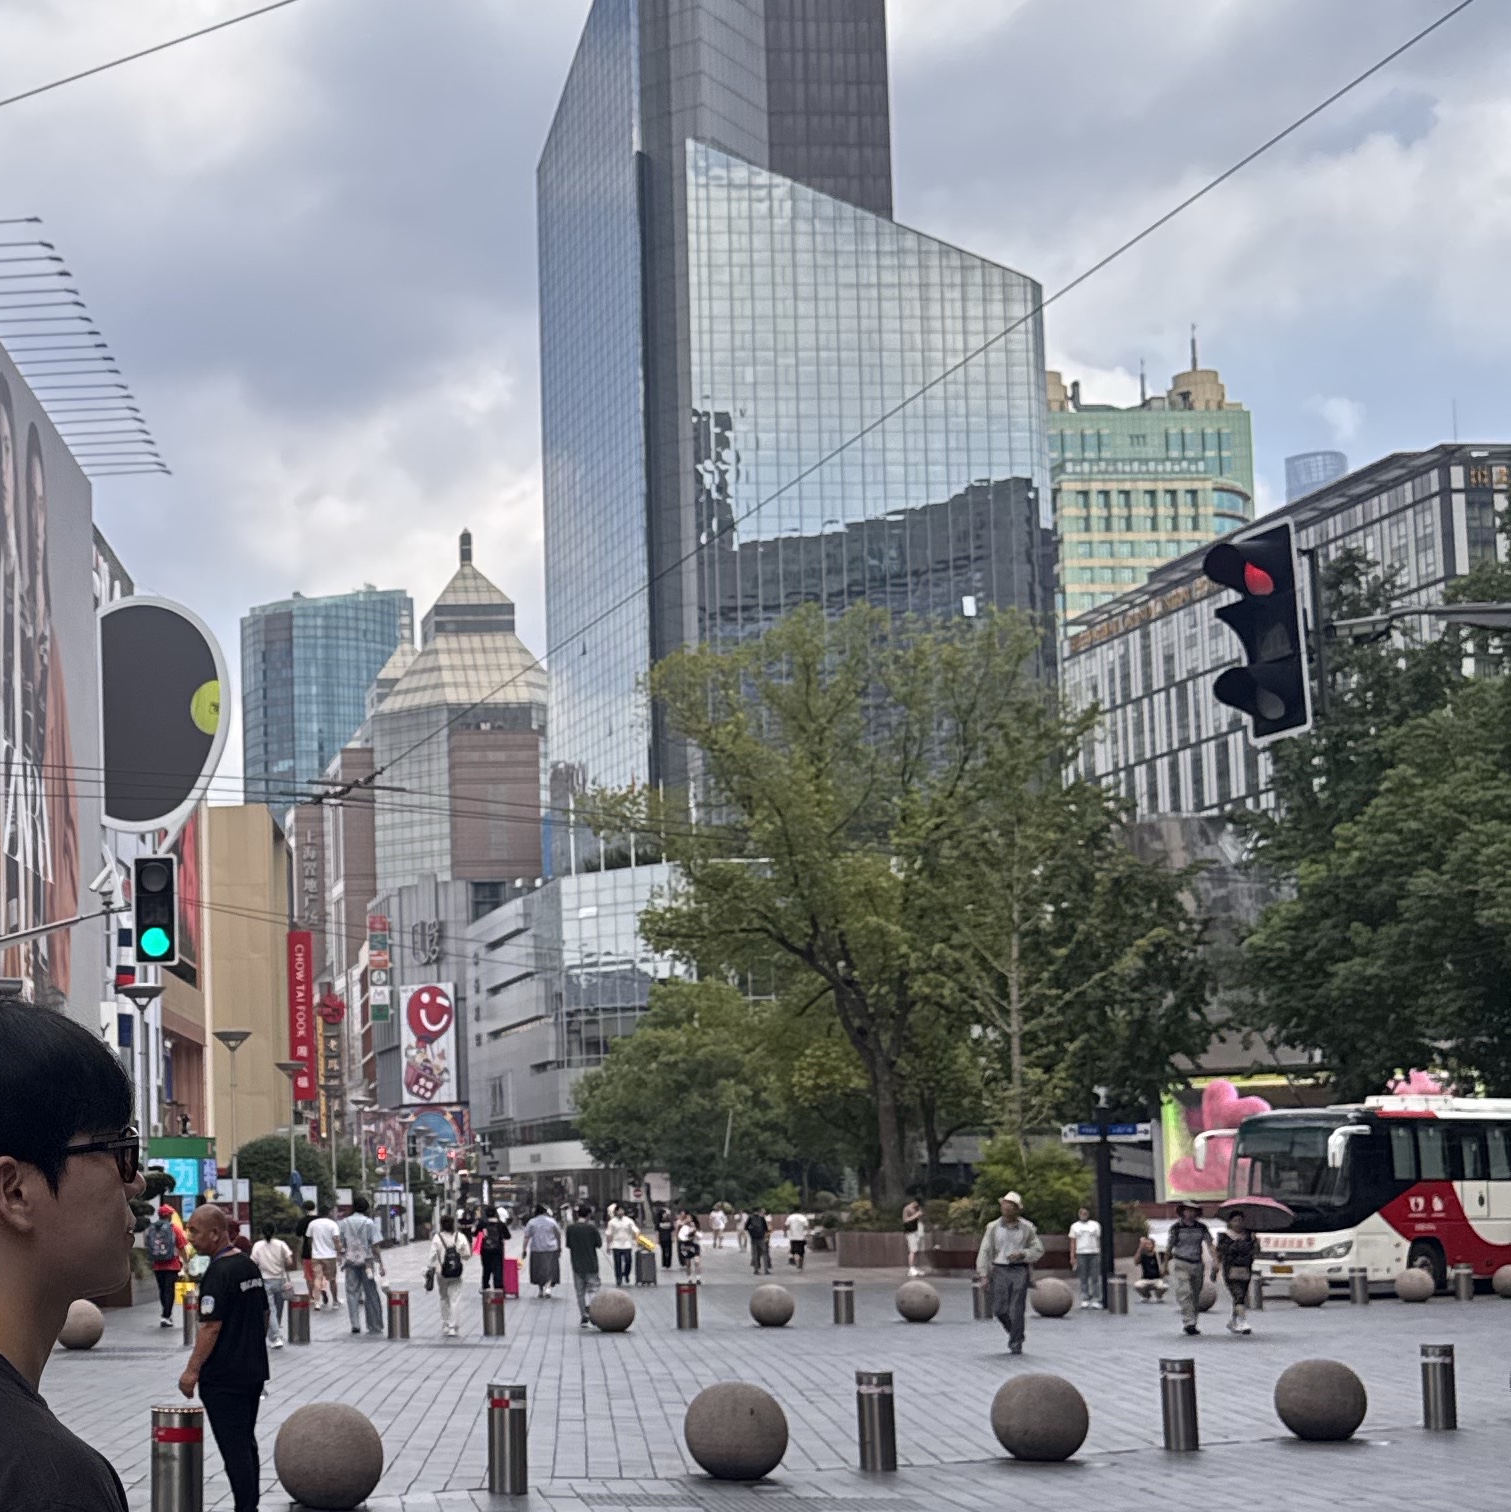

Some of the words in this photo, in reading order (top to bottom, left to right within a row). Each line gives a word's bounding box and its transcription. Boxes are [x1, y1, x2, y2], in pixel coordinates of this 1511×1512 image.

[294, 943, 306, 981] CHOW
[295, 985, 307, 1003] TAI
[296, 1006, 308, 1037] FOOK
[296, 1046, 309, 1088] 周福
